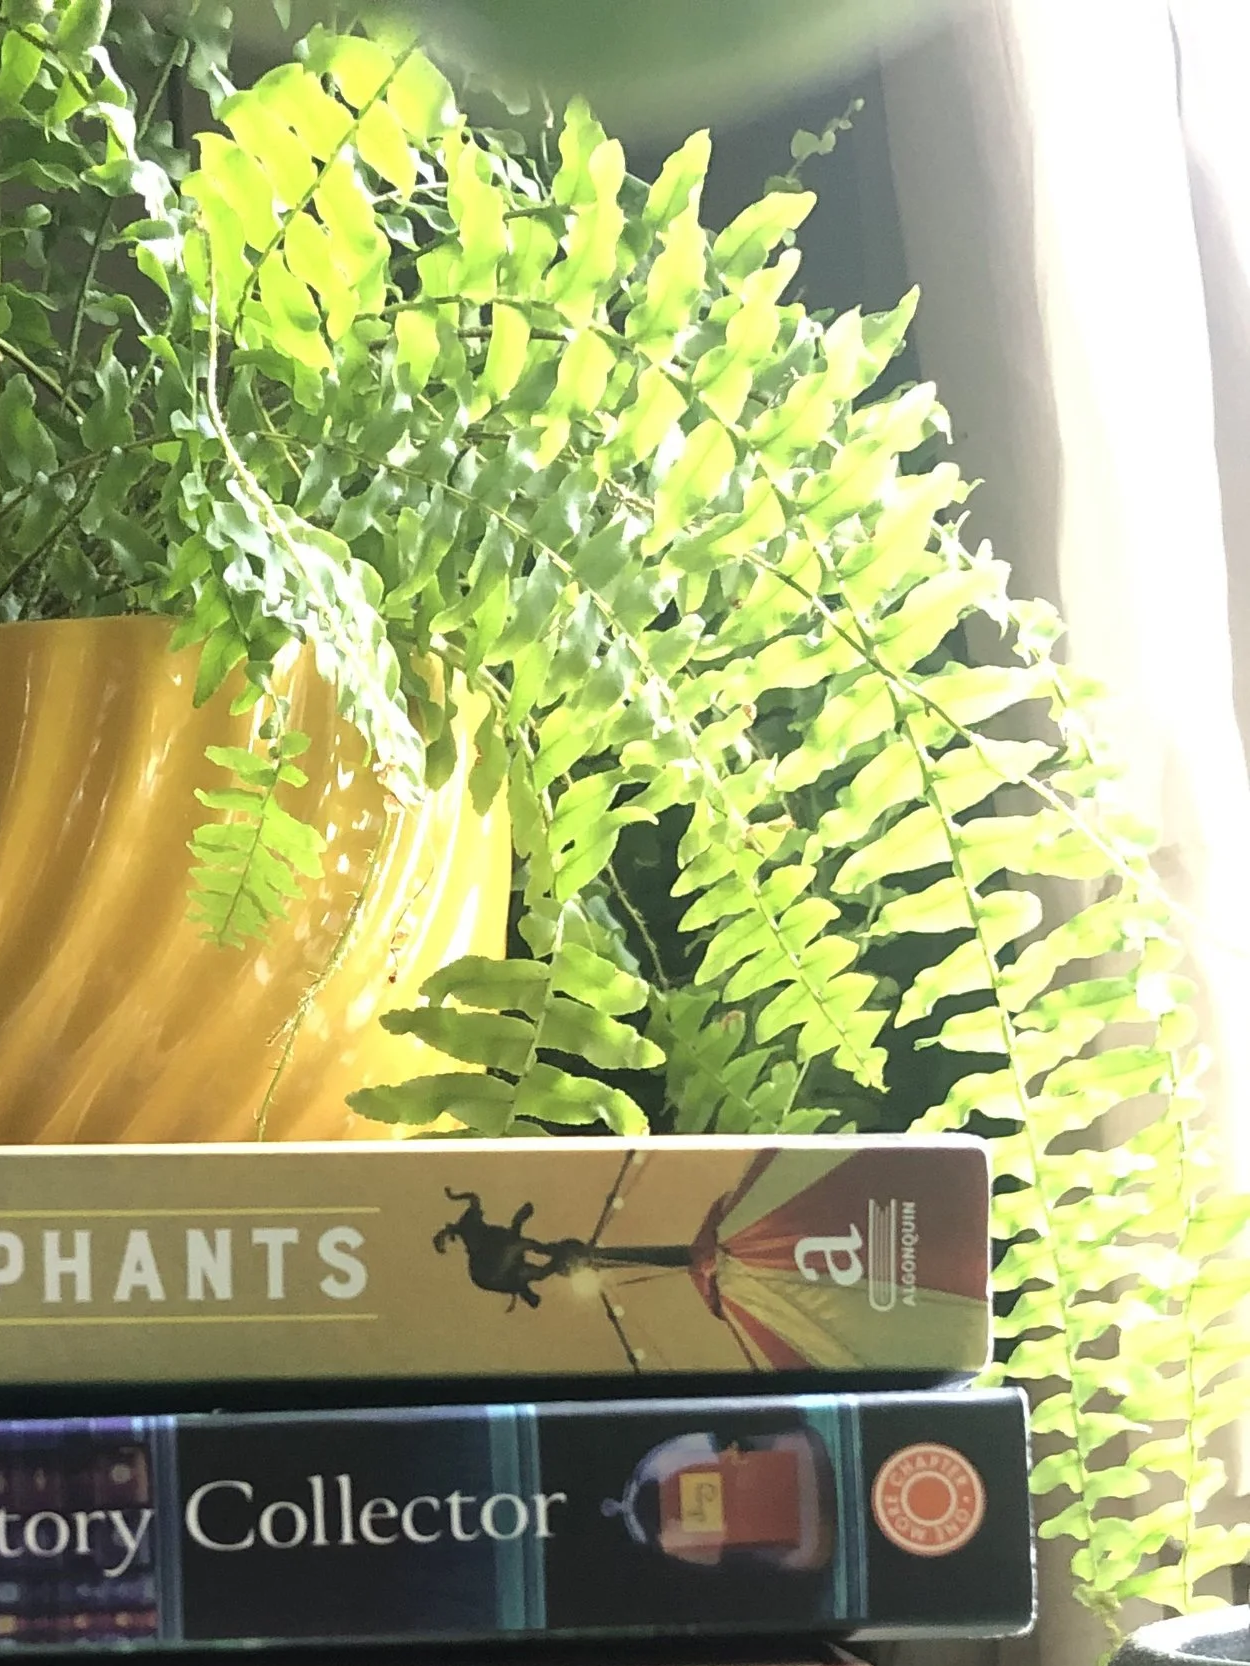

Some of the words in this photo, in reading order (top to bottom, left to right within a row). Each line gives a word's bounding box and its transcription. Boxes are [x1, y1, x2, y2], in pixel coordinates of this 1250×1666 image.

[901, 1201, 919, 1307] ALGONQUIN
[888, 1452, 969, 1488] CHAPTER
[185, 1474, 567, 1552] Collector
